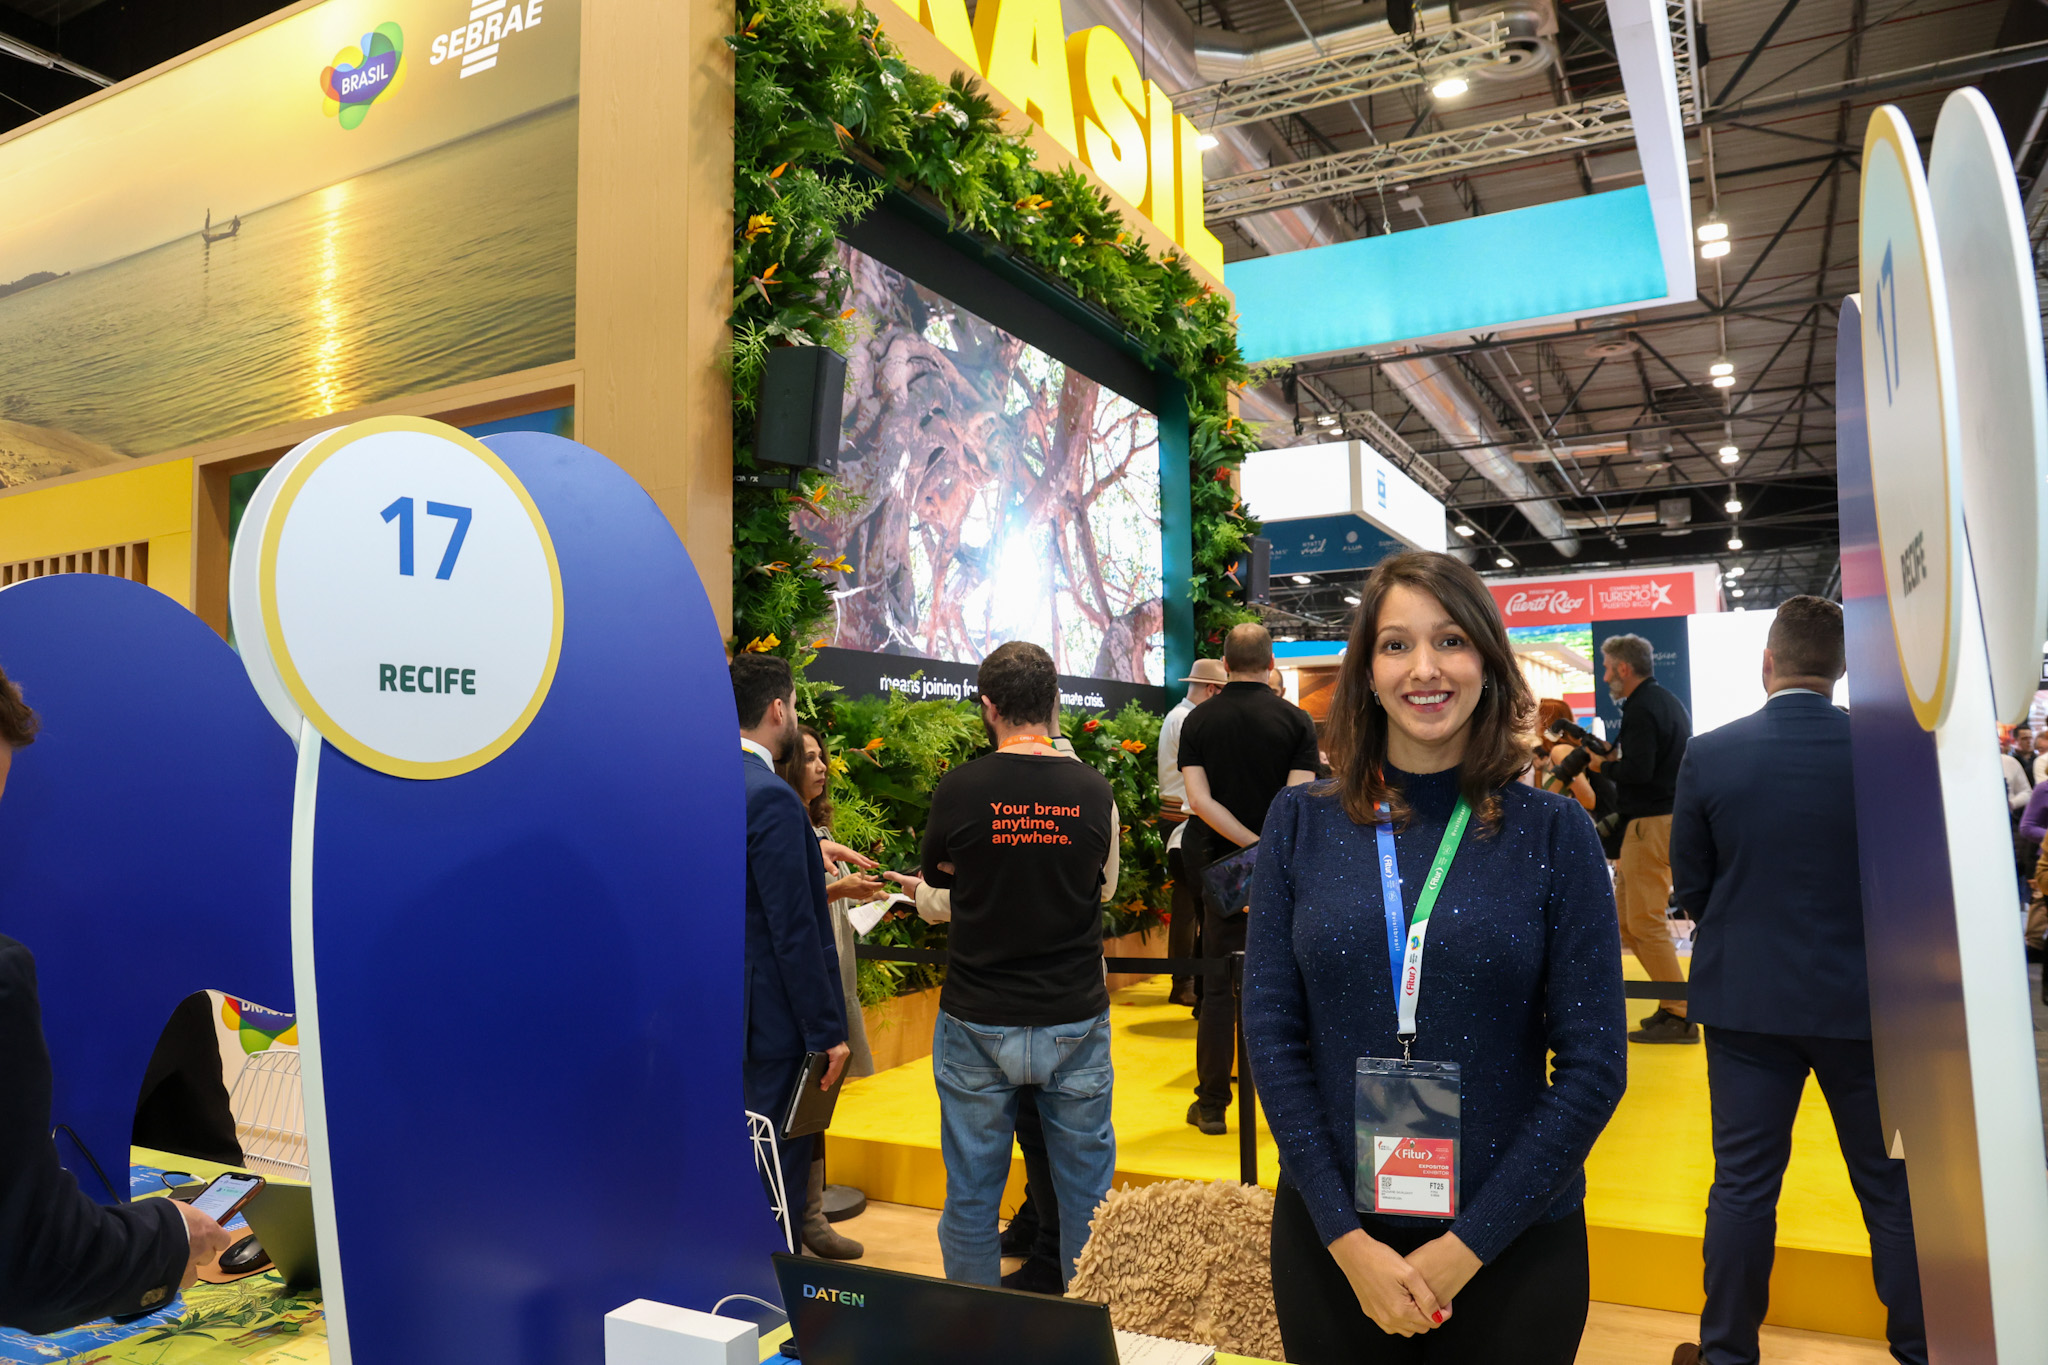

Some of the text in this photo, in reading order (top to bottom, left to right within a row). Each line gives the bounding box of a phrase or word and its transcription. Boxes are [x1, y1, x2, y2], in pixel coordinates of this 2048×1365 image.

[429, 0, 544, 66] SEBRAE
[341, 63, 389, 96] BRASIL
[1876, 238, 1900, 408] 17
[380, 496, 472, 581] 17
[1901, 530, 1928, 598] RECIFE
[1505, 590, 1585, 616] Puerto Rico
[1599, 590, 1651, 603] TURISMO
[379, 663, 476, 695] RECIFE
[880, 677, 921, 694] means
[922, 676, 961, 701] joining
[1084, 692, 1105, 708] crisis.
[990, 802, 1080, 817] Your brand
[991, 816, 1059, 832] anytime,
[992, 831, 1072, 846] anywhere.
[1391, 911, 1400, 952] @visitbrasil
[1429, 1182, 1444, 1190] FT25
[803, 1283, 865, 1308] DATEN
